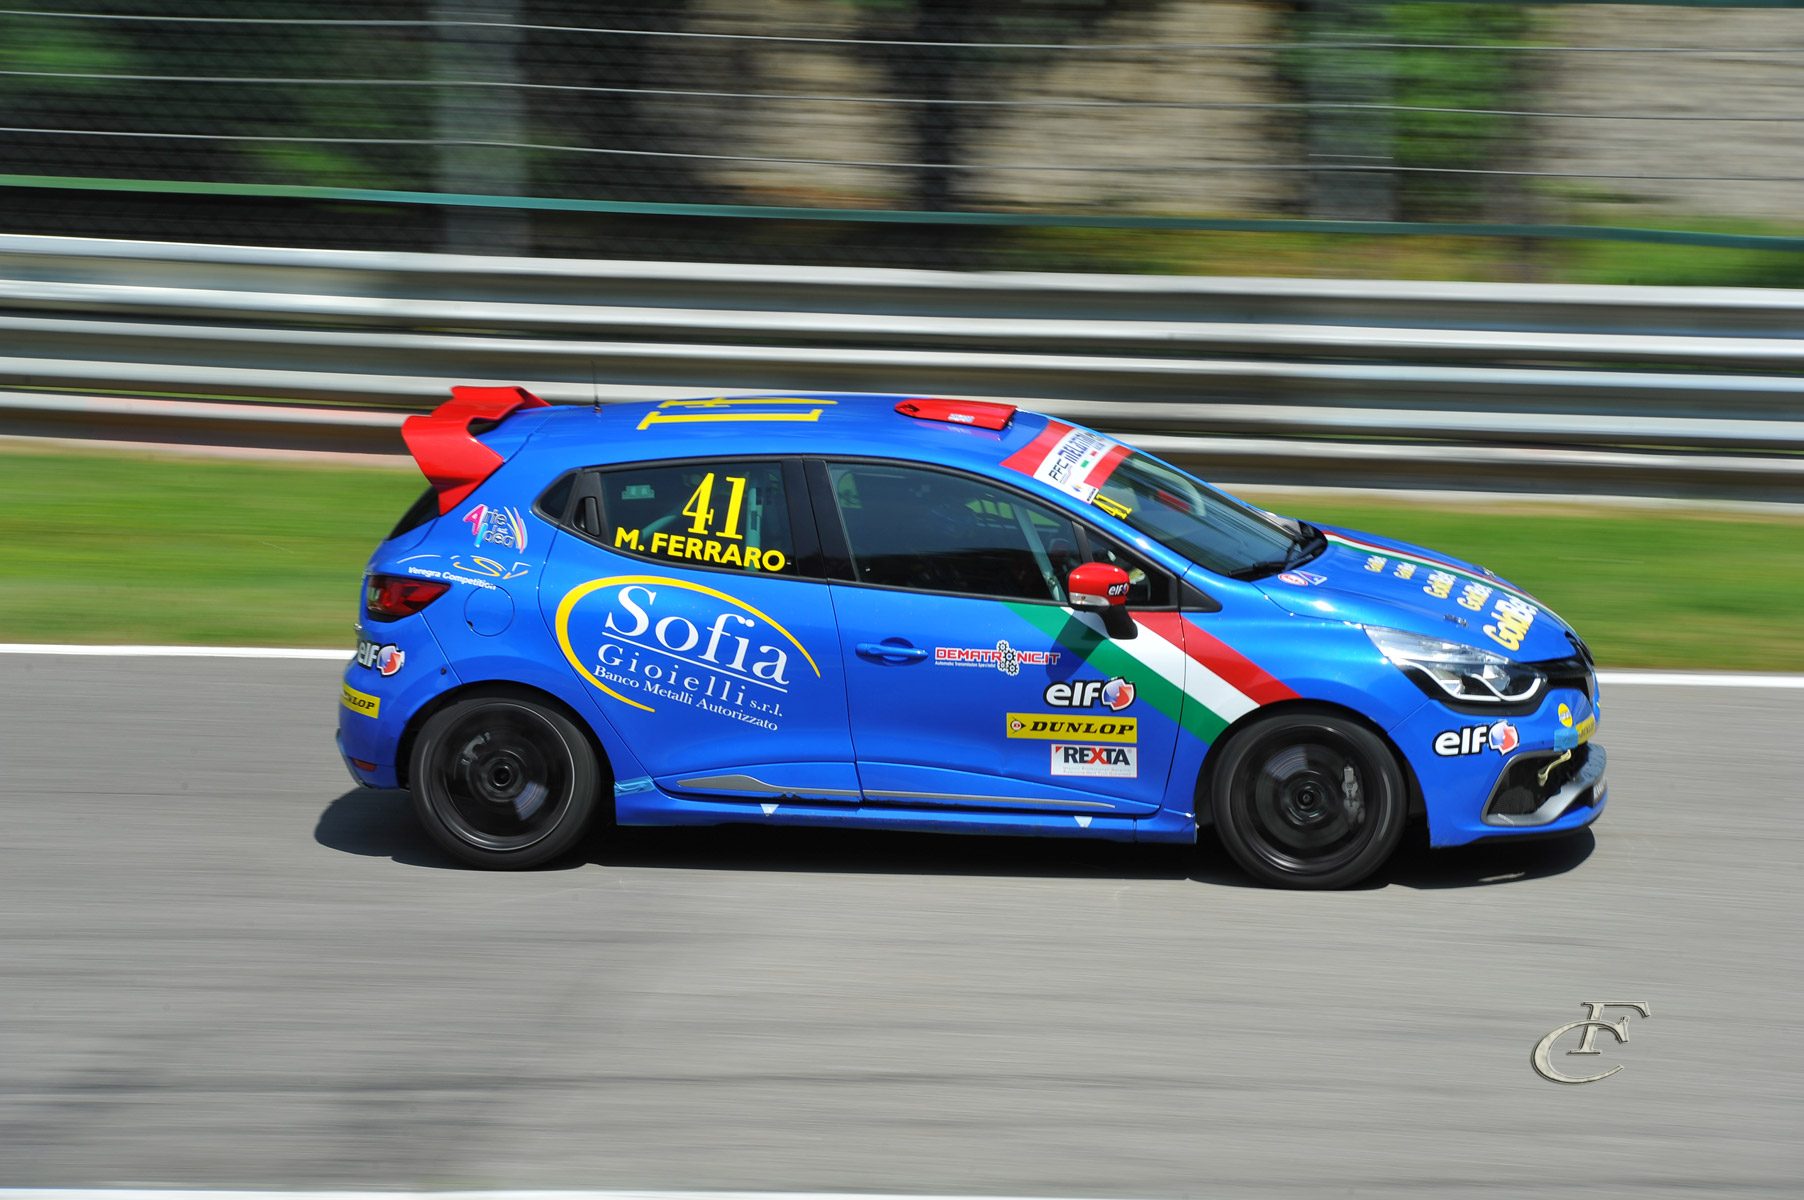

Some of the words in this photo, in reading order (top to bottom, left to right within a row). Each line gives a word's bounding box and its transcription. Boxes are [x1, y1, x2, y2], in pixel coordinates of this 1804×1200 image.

[1048, 459, 1070, 481] PFC
[682, 472, 746, 540] 41
[1093, 493, 1132, 520] 41
[614, 527, 645, 552] M.
[651, 532, 786, 572] FERRARO
[1108, 584, 1123, 596] elf
[604, 585, 789, 685] Sofia
[357, 640, 381, 668] elf
[598, 643, 747, 706] Gioielli
[750, 699, 783, 717] s.r.l.
[343, 690, 375, 710] NLOP
[594, 664, 640, 688] Banco
[643, 680, 693, 705] Metalli
[695, 697, 778, 731] Autorizzato
[1046, 682, 1101, 706] elf
[1030, 721, 1135, 735] DUNLOP
[1434, 727, 1488, 756] elf
[1063, 746, 1131, 766] REXTA
